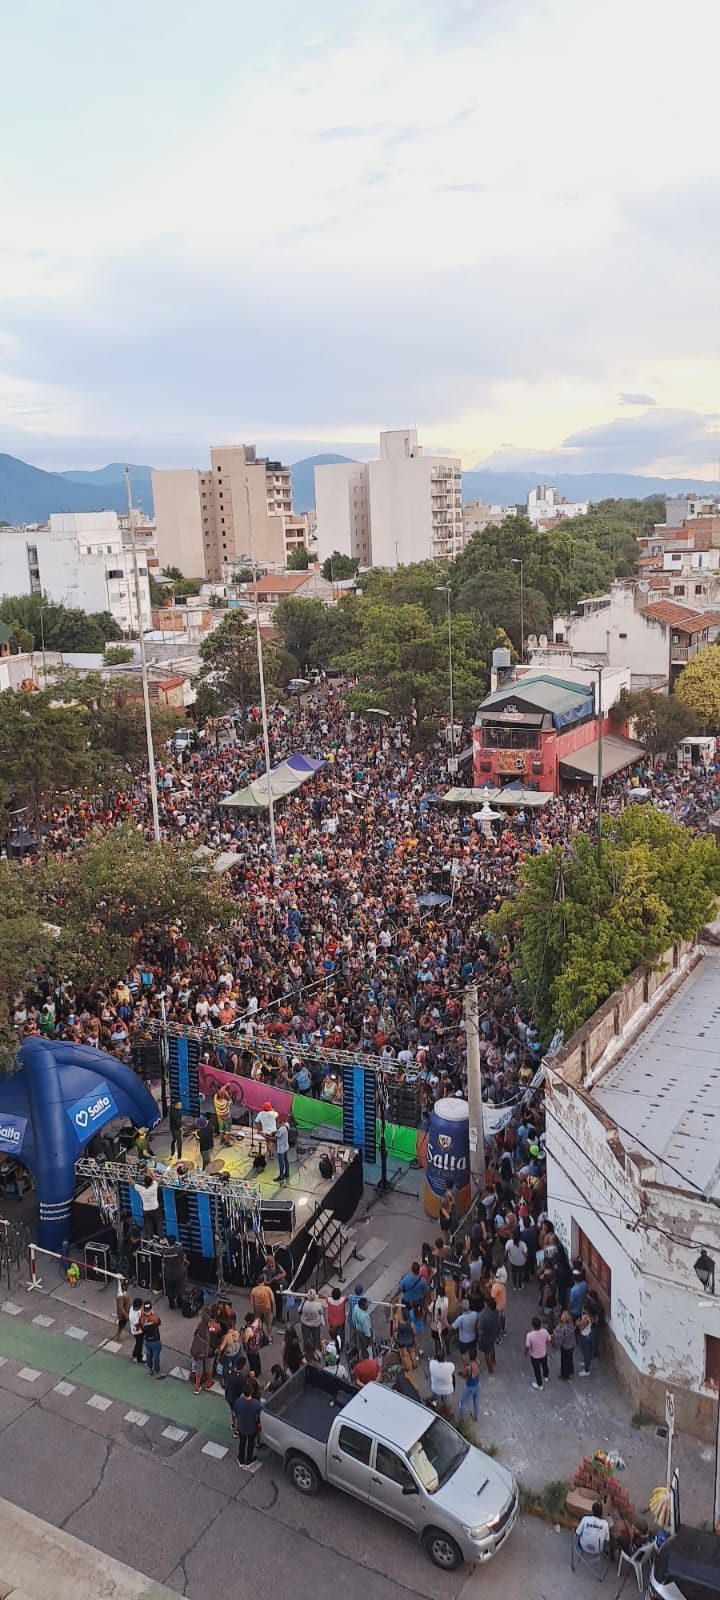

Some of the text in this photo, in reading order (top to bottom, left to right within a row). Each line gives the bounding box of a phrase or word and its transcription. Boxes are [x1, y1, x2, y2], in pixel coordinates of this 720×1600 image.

[88, 1096, 110, 1117] Salta
[0, 1124, 20, 1140] alta
[427, 1143, 466, 1171] Salta
